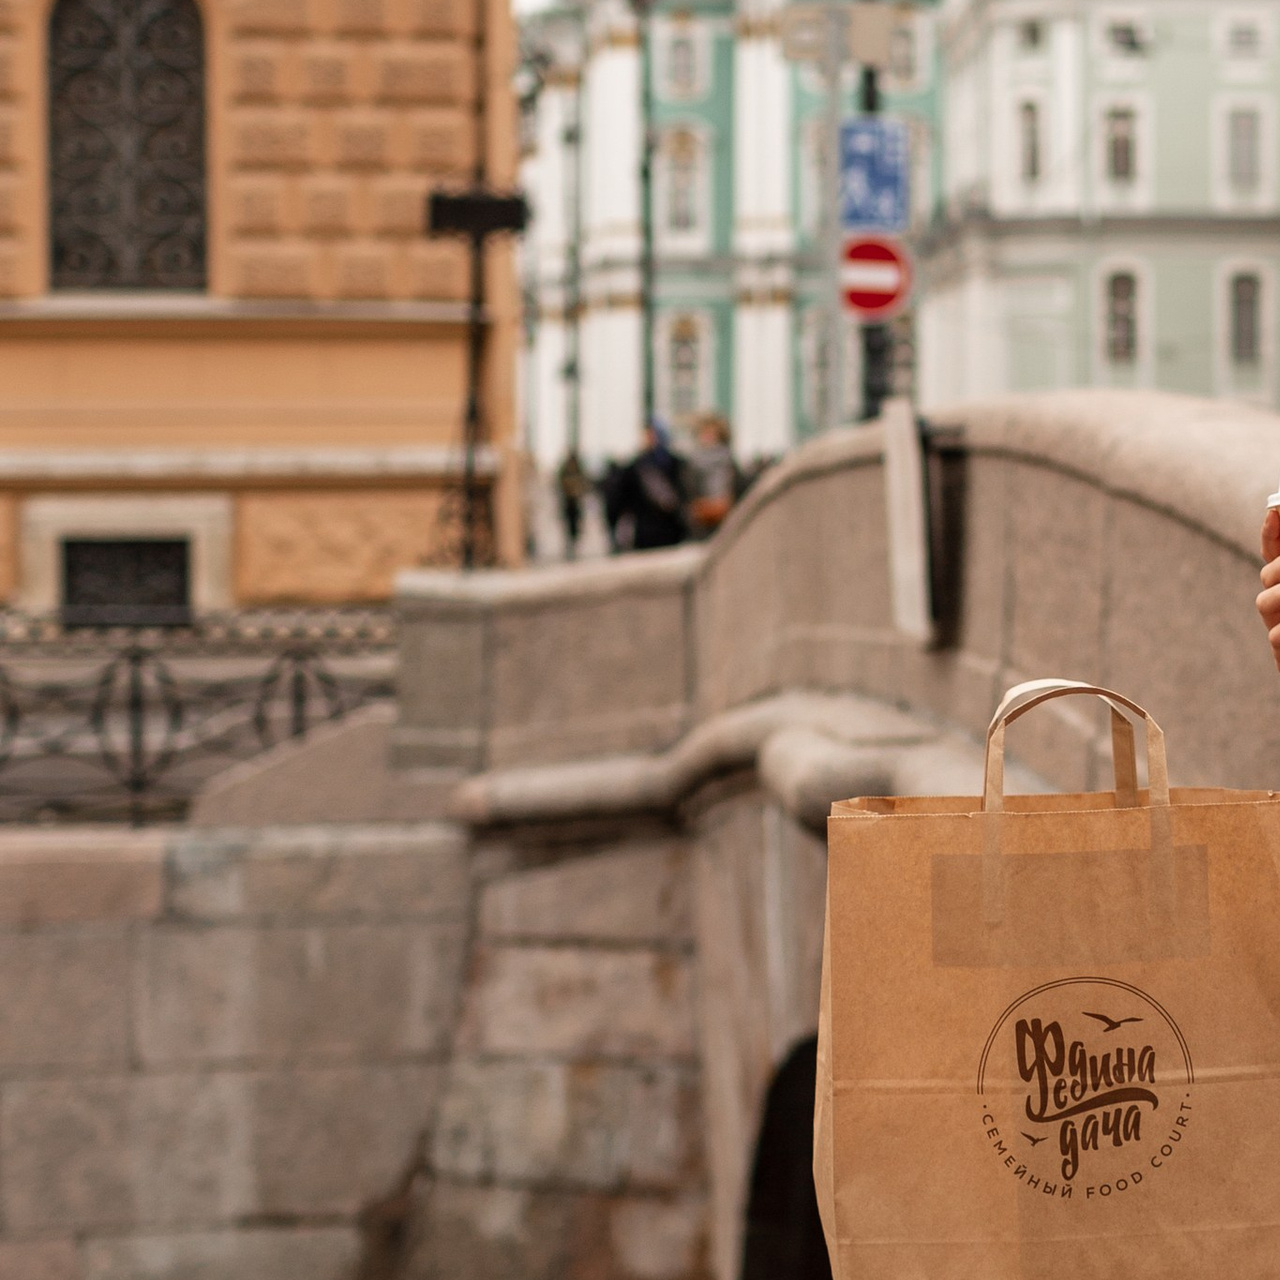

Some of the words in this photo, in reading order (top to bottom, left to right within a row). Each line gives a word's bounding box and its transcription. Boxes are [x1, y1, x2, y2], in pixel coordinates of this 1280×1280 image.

[982, 1114, 1072, 1198] СЕМЕЙНЫЙ
[1086, 1171, 1143, 1199] FOOD
[1151, 1101, 1192, 1168] COURT
[1059, 1105, 1141, 1180] дача
